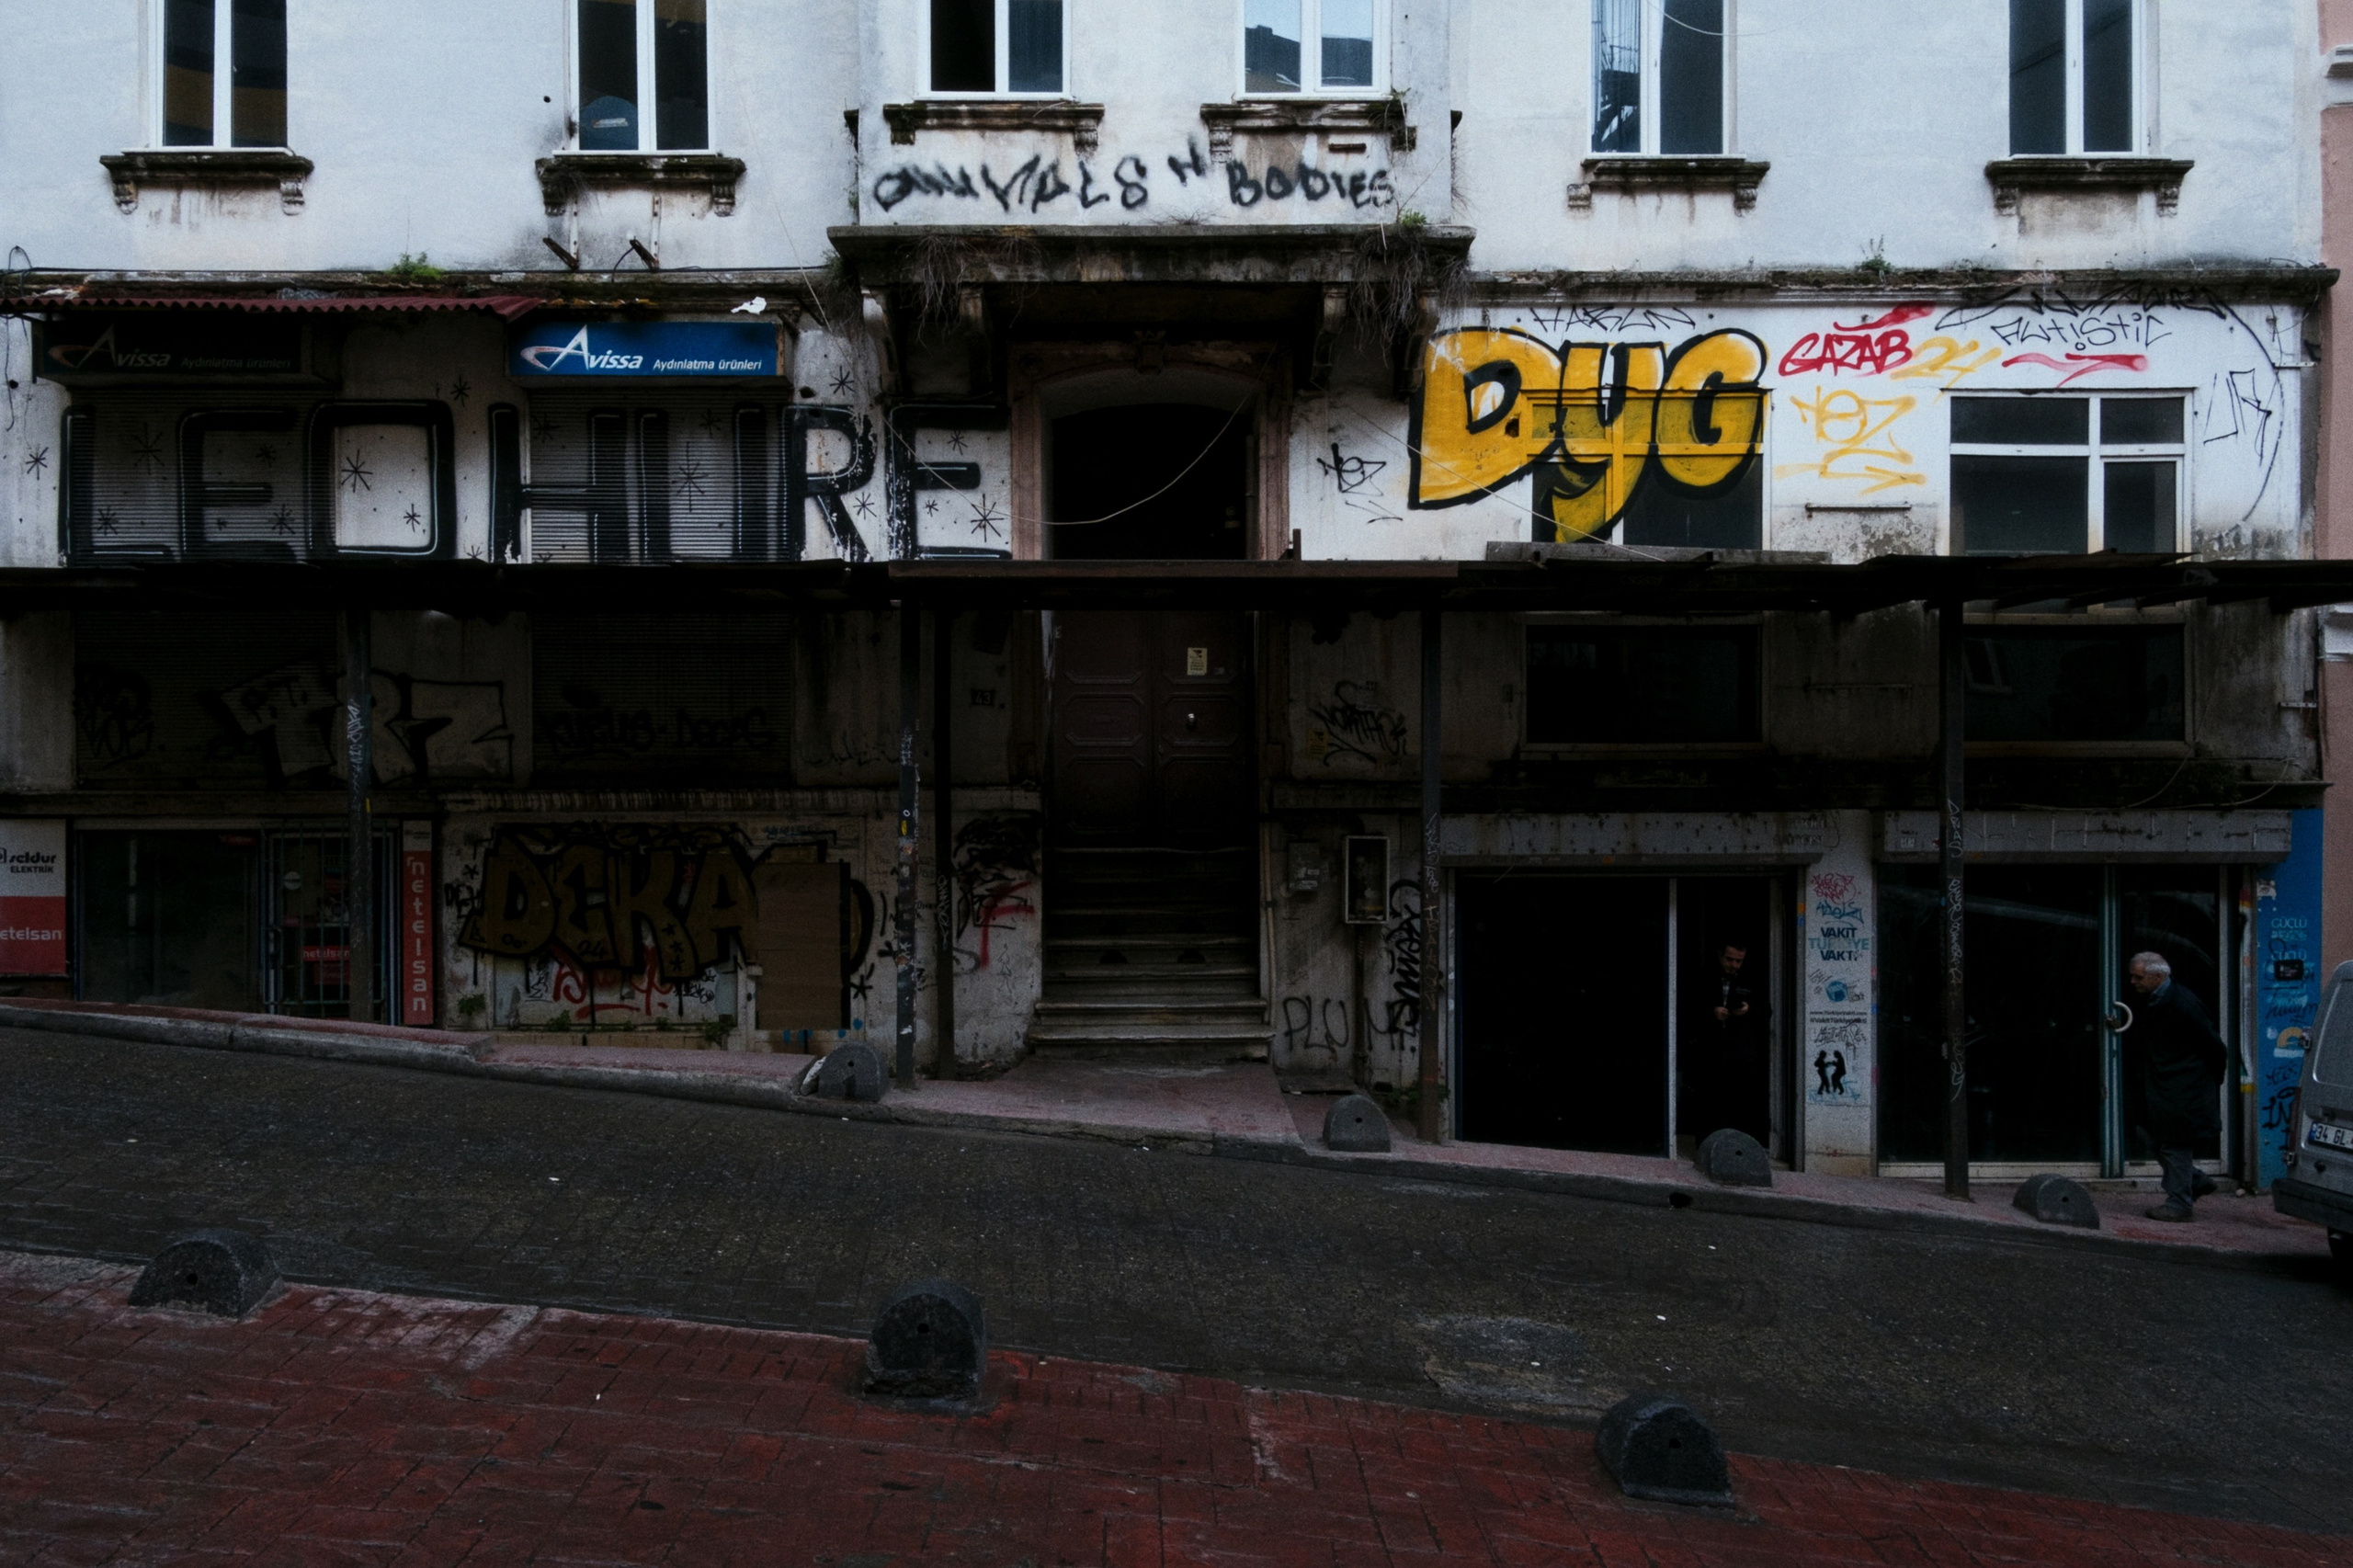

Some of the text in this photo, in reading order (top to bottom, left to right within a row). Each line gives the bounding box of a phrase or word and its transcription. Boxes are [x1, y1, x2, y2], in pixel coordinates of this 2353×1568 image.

[1226, 156, 1394, 208] BODIES
[75, 323, 172, 369] Avissa
[551, 324, 762, 372] Avissa Aydınlatma ürünleri
[10, 865, 54, 873] ELEKTRİK
[1820, 926, 1858, 938] VAKİT
[576, 939, 609, 960] 24
[2315, 1125, 2328, 1142] 34
